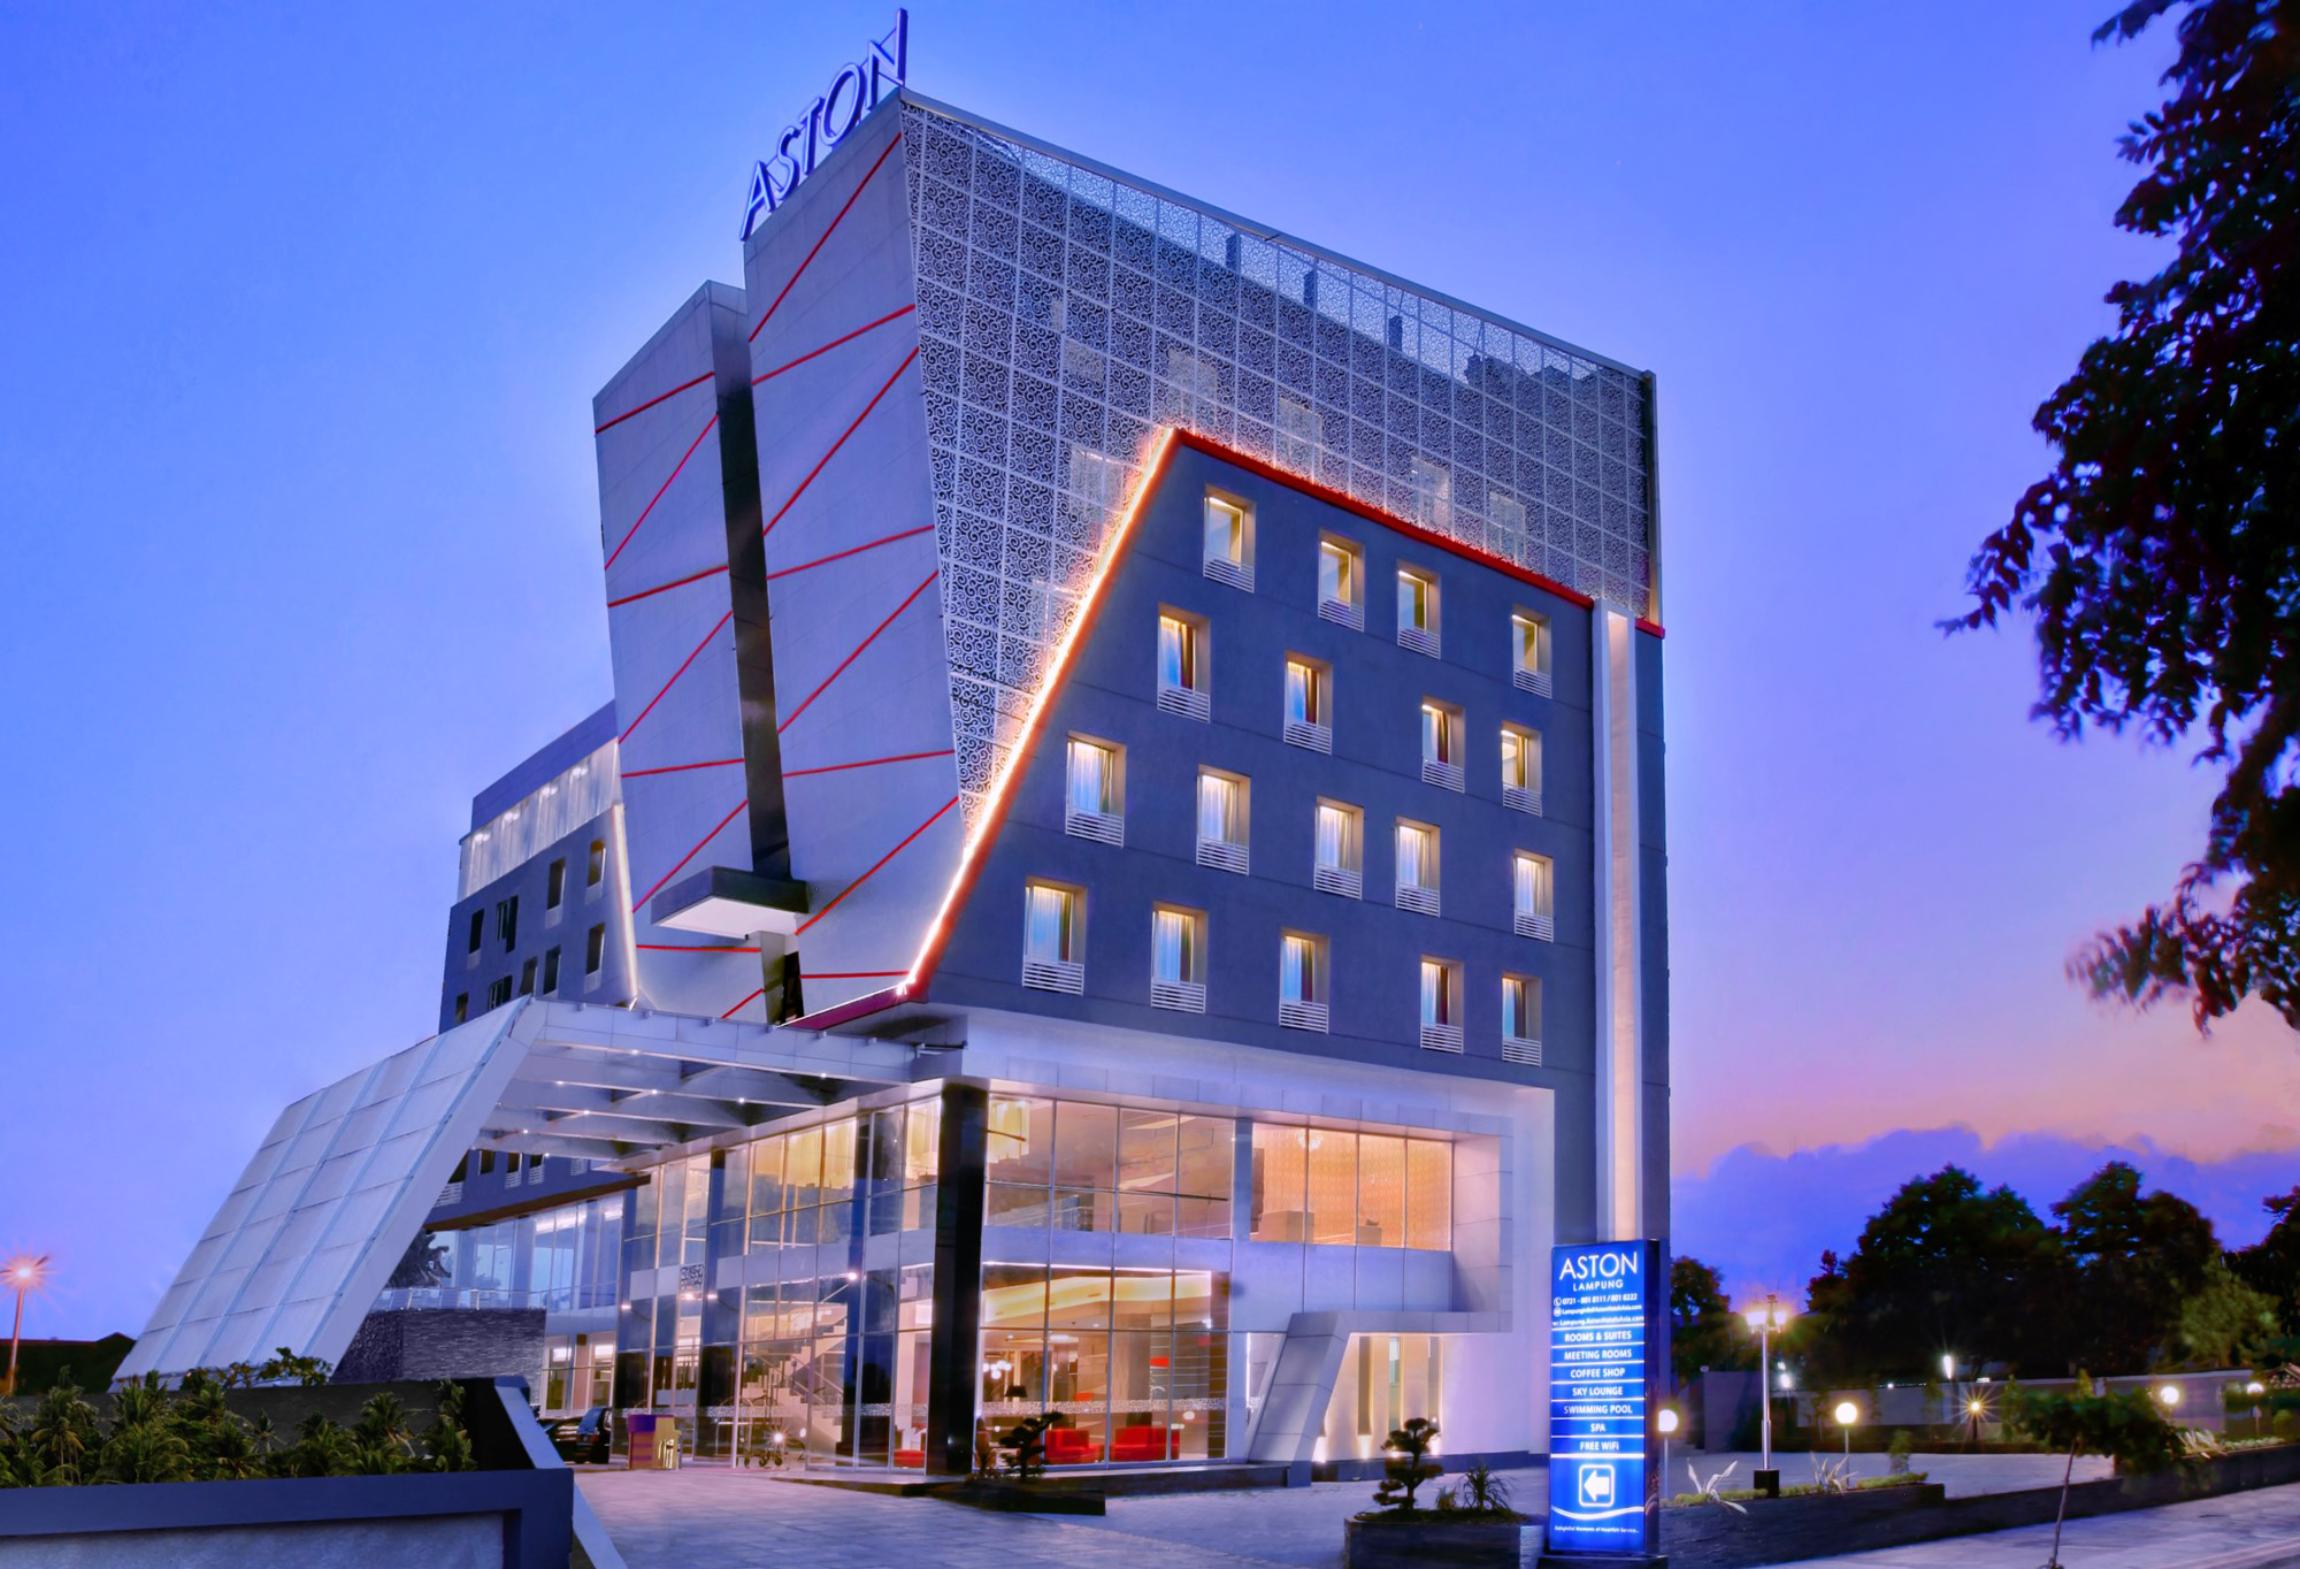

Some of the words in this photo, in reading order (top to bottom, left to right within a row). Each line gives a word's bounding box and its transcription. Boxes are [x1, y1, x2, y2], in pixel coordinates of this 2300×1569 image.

[740, 8, 908, 241] ASTON
[1559, 1252, 1638, 1280] ASTON
[1573, 1279, 1624, 1291] LAMPUNG
[1564, 1332, 1594, 1342] ROOMS
[1604, 1330, 1632, 1340] SUITES
[1564, 1351, 1600, 1360] MEETING
[1602, 1349, 1632, 1359] ROOMS
[1570, 1369, 1600, 1378] COFFEE
[1603, 1367, 1626, 1377] SHOP
[1572, 1387, 1587, 1396] SKY
[1589, 1386, 1623, 1396] LOUNGE
[1564, 1405, 1608, 1414] SWIMMING
[1610, 1404, 1633, 1414] POOL
[1590, 1423, 1606, 1433] SPA
[1580, 1441, 1600, 1450] FREE
